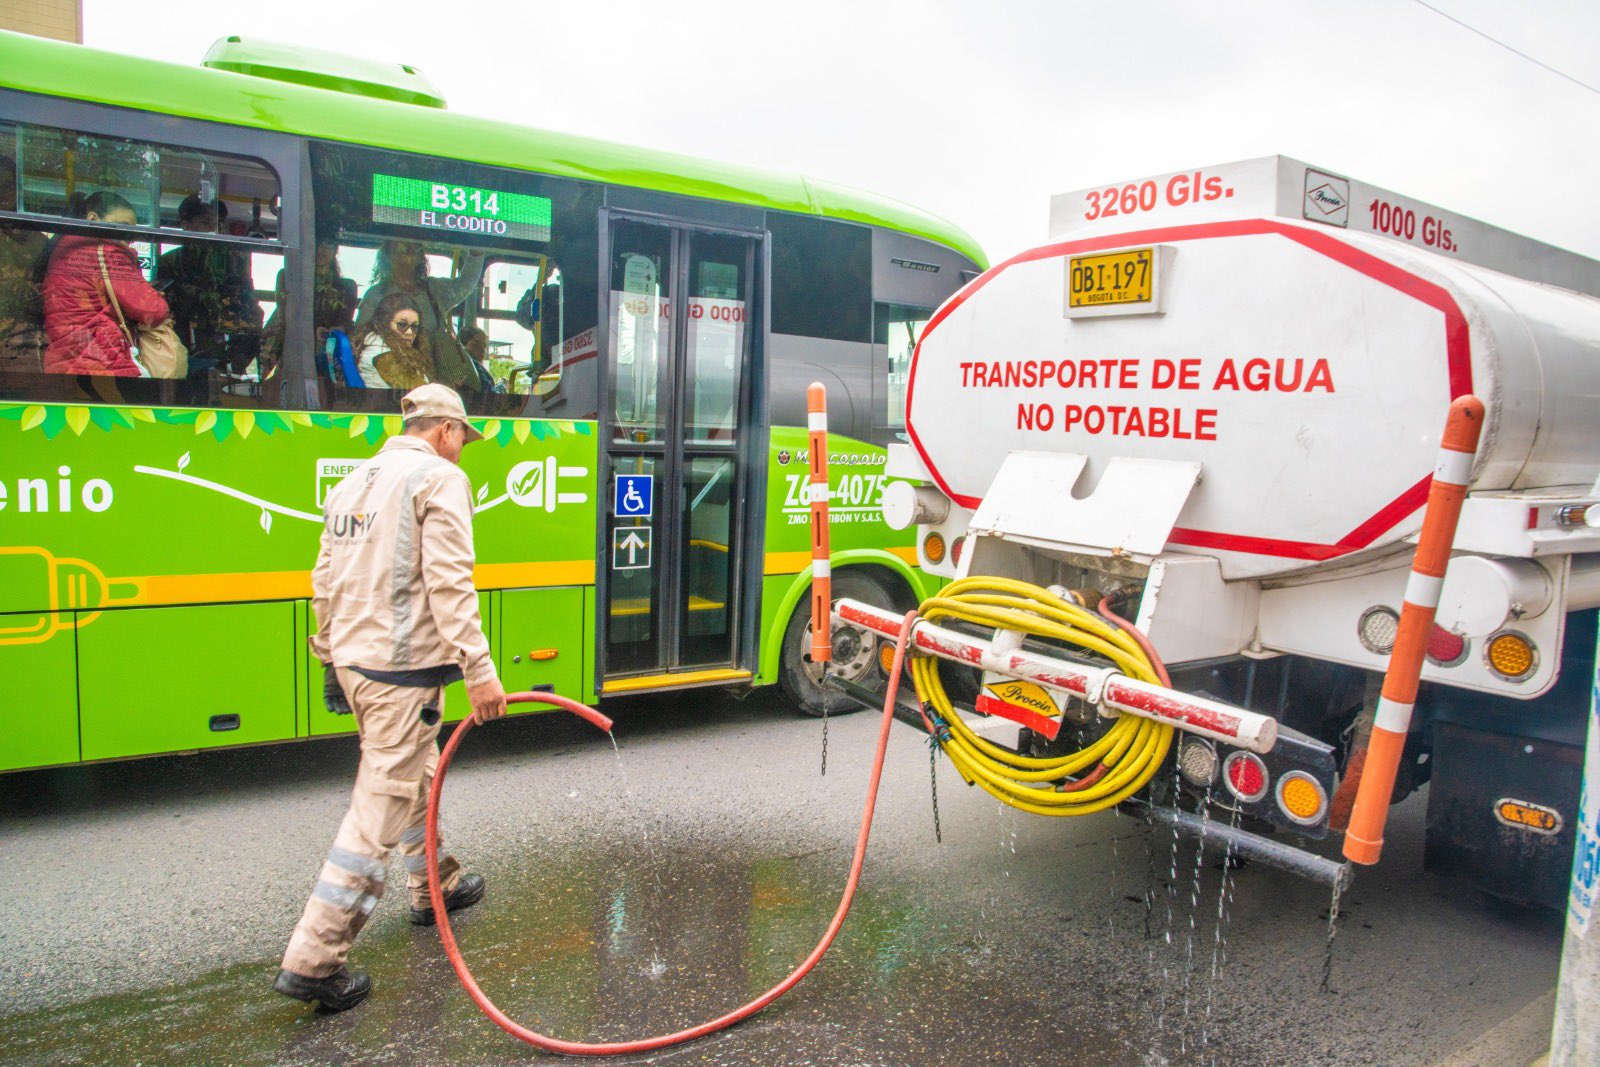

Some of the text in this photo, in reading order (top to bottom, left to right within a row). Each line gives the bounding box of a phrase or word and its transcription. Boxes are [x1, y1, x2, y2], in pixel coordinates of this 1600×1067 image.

[431, 183, 500, 216] B314
[1084, 180, 1157, 221] 3260
[420, 210, 507, 235] EL CODITO
[1369, 199, 1416, 240] 1000
[960, 358, 1336, 393] TRANSPORTE DE AGUA
[1016, 403, 1218, 441] NO POTABLE
[793, 450, 886, 466] Mcopolo
[784, 474, 888, 506] Z6-4075
[333, 511, 378, 538] UMV
[788, 514, 808, 525] ZMO
[854, 513, 860, 523] V
[861, 512, 882, 523] S.A.S.
